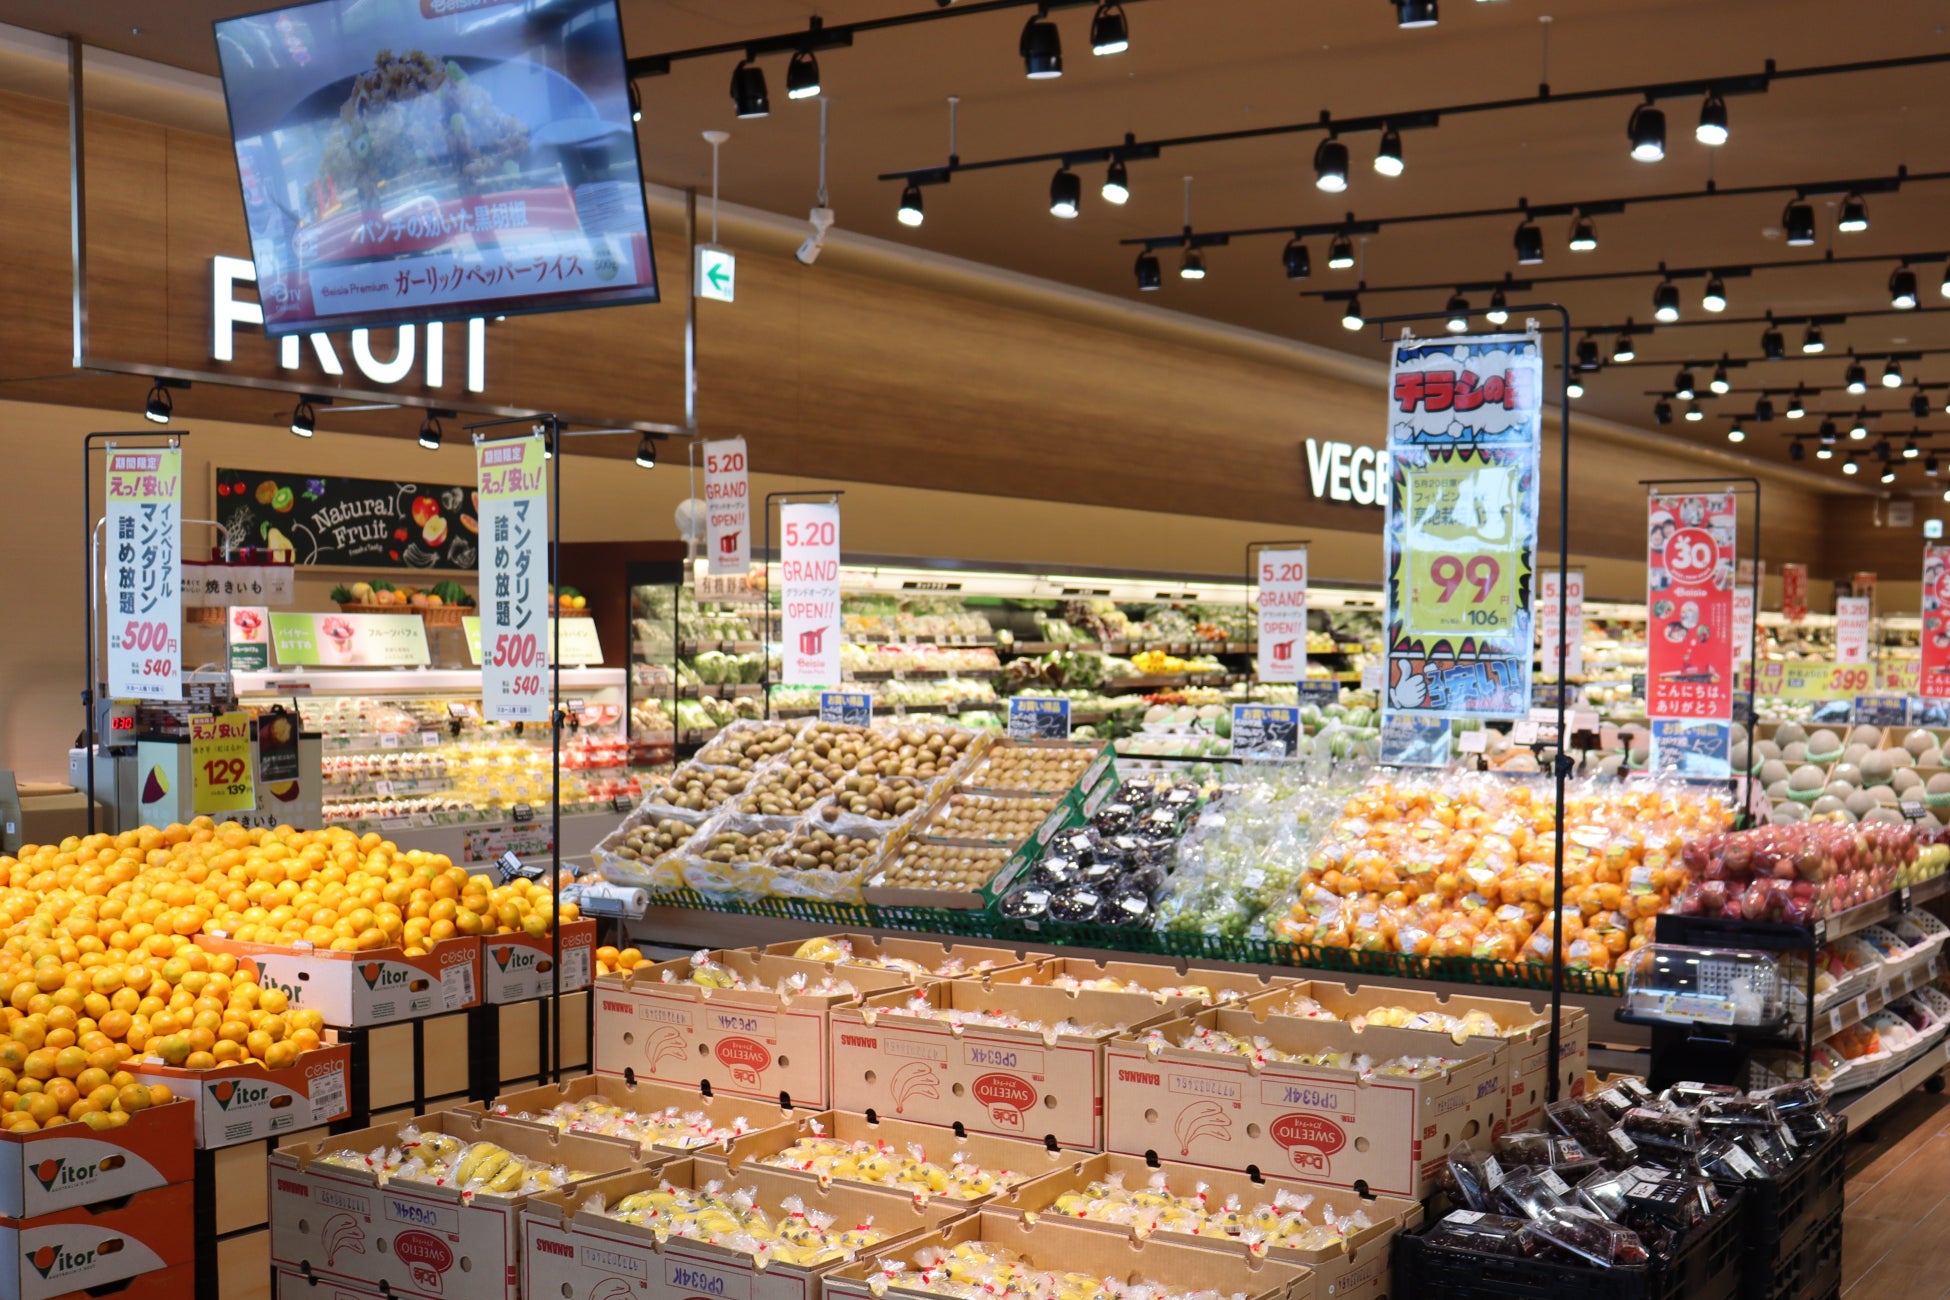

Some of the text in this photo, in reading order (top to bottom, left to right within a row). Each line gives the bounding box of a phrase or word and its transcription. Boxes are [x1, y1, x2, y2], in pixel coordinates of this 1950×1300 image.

[395, 254, 583, 295] ガーリックペッパーライス
[350, 282, 389, 295] Premium
[707, 452, 745, 474] 5.20
[705, 481, 747, 500] GRAND
[311, 496, 395, 535] Natural
[711, 512, 745, 527] OPEN!!
[332, 520, 389, 549] Fruit
[785, 521, 835, 546] 5.20
[141, 503, 158, 614] マンダリン
[161, 503, 174, 598] インペリアル
[1671, 538, 1712, 570] 30
[119, 516, 136, 615] 詰め放題
[494, 515, 511, 627] 詰め放題
[513, 499, 532, 630] マンダリン
[783, 559, 837, 581] GRAND
[1262, 563, 1304, 582] 5.20
[205, 579, 262, 594] 焼きいも
[1260, 591, 1305, 608] GRAND
[788, 602, 834, 619] OPEN!!
[1543, 604, 1582, 617] GRND
[1656, 701, 1718, 715] ありがとう
[491, 946, 535, 974] Vitor
[358, 962, 408, 991] Vitor
[841, 1034, 877, 1049] BANANAS
[722, 1048, 763, 1062] SWEETIO
[971, 1047, 1017, 1067] CPG34K
[734, 1068, 755, 1084] Dole
[1118, 1069, 1160, 1086] BANANAS
[208, 1079, 268, 1112] Vitor
[980, 1084, 1028, 1101] SWEETIO
[1283, 1085, 1337, 1110] CPG34K
[993, 1107, 1018, 1125] Dole
[1279, 1124, 1336, 1144] SWEETIO
[1294, 1151, 1324, 1170] Dole
[29, 1158, 97, 1193] Vitor
[393, 1201, 437, 1226] CPG34K
[401, 1242, 446, 1262] SWEETIO
[536, 1238, 574, 1259] BANANAS
[25, 1244, 95, 1280] Vitor
[414, 1267, 437, 1287] Dole
[673, 1266, 724, 1294] CPG34K
